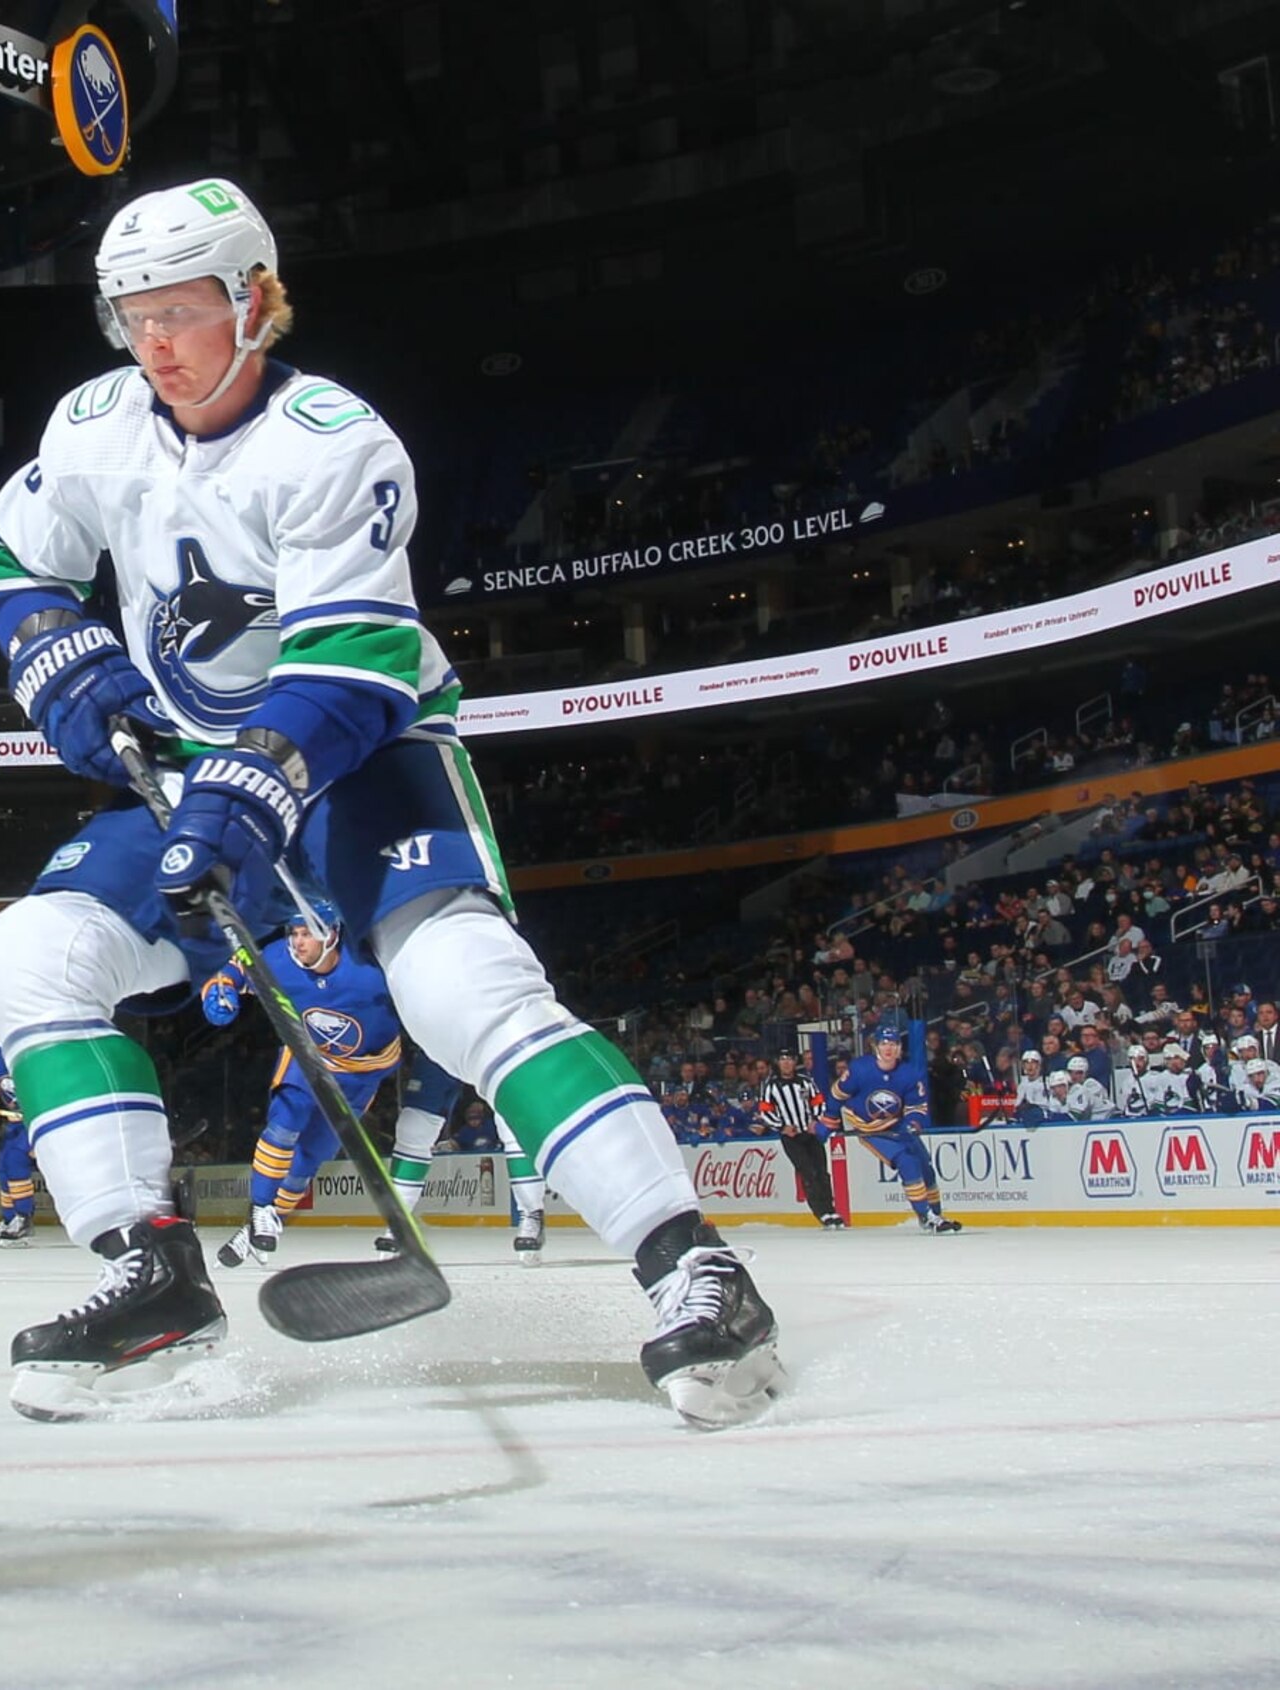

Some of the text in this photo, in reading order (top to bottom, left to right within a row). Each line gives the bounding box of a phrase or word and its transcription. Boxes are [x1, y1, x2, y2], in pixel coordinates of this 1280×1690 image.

[191, 184, 234, 211] TD
[371, 480, 401, 551] 3
[483, 508, 853, 592] SENECA BUFFALO CREEK 300 LEVEL
[14, 626, 123, 719] WARRIOR
[694, 1148, 778, 1199] Coca-Cola
[878, 1138, 1035, 1183] LCOM
[1087, 1176, 1132, 1188] MARATHON
[317, 1175, 365, 1196] TOYOTA
[421, 1168, 480, 1207] uengling
